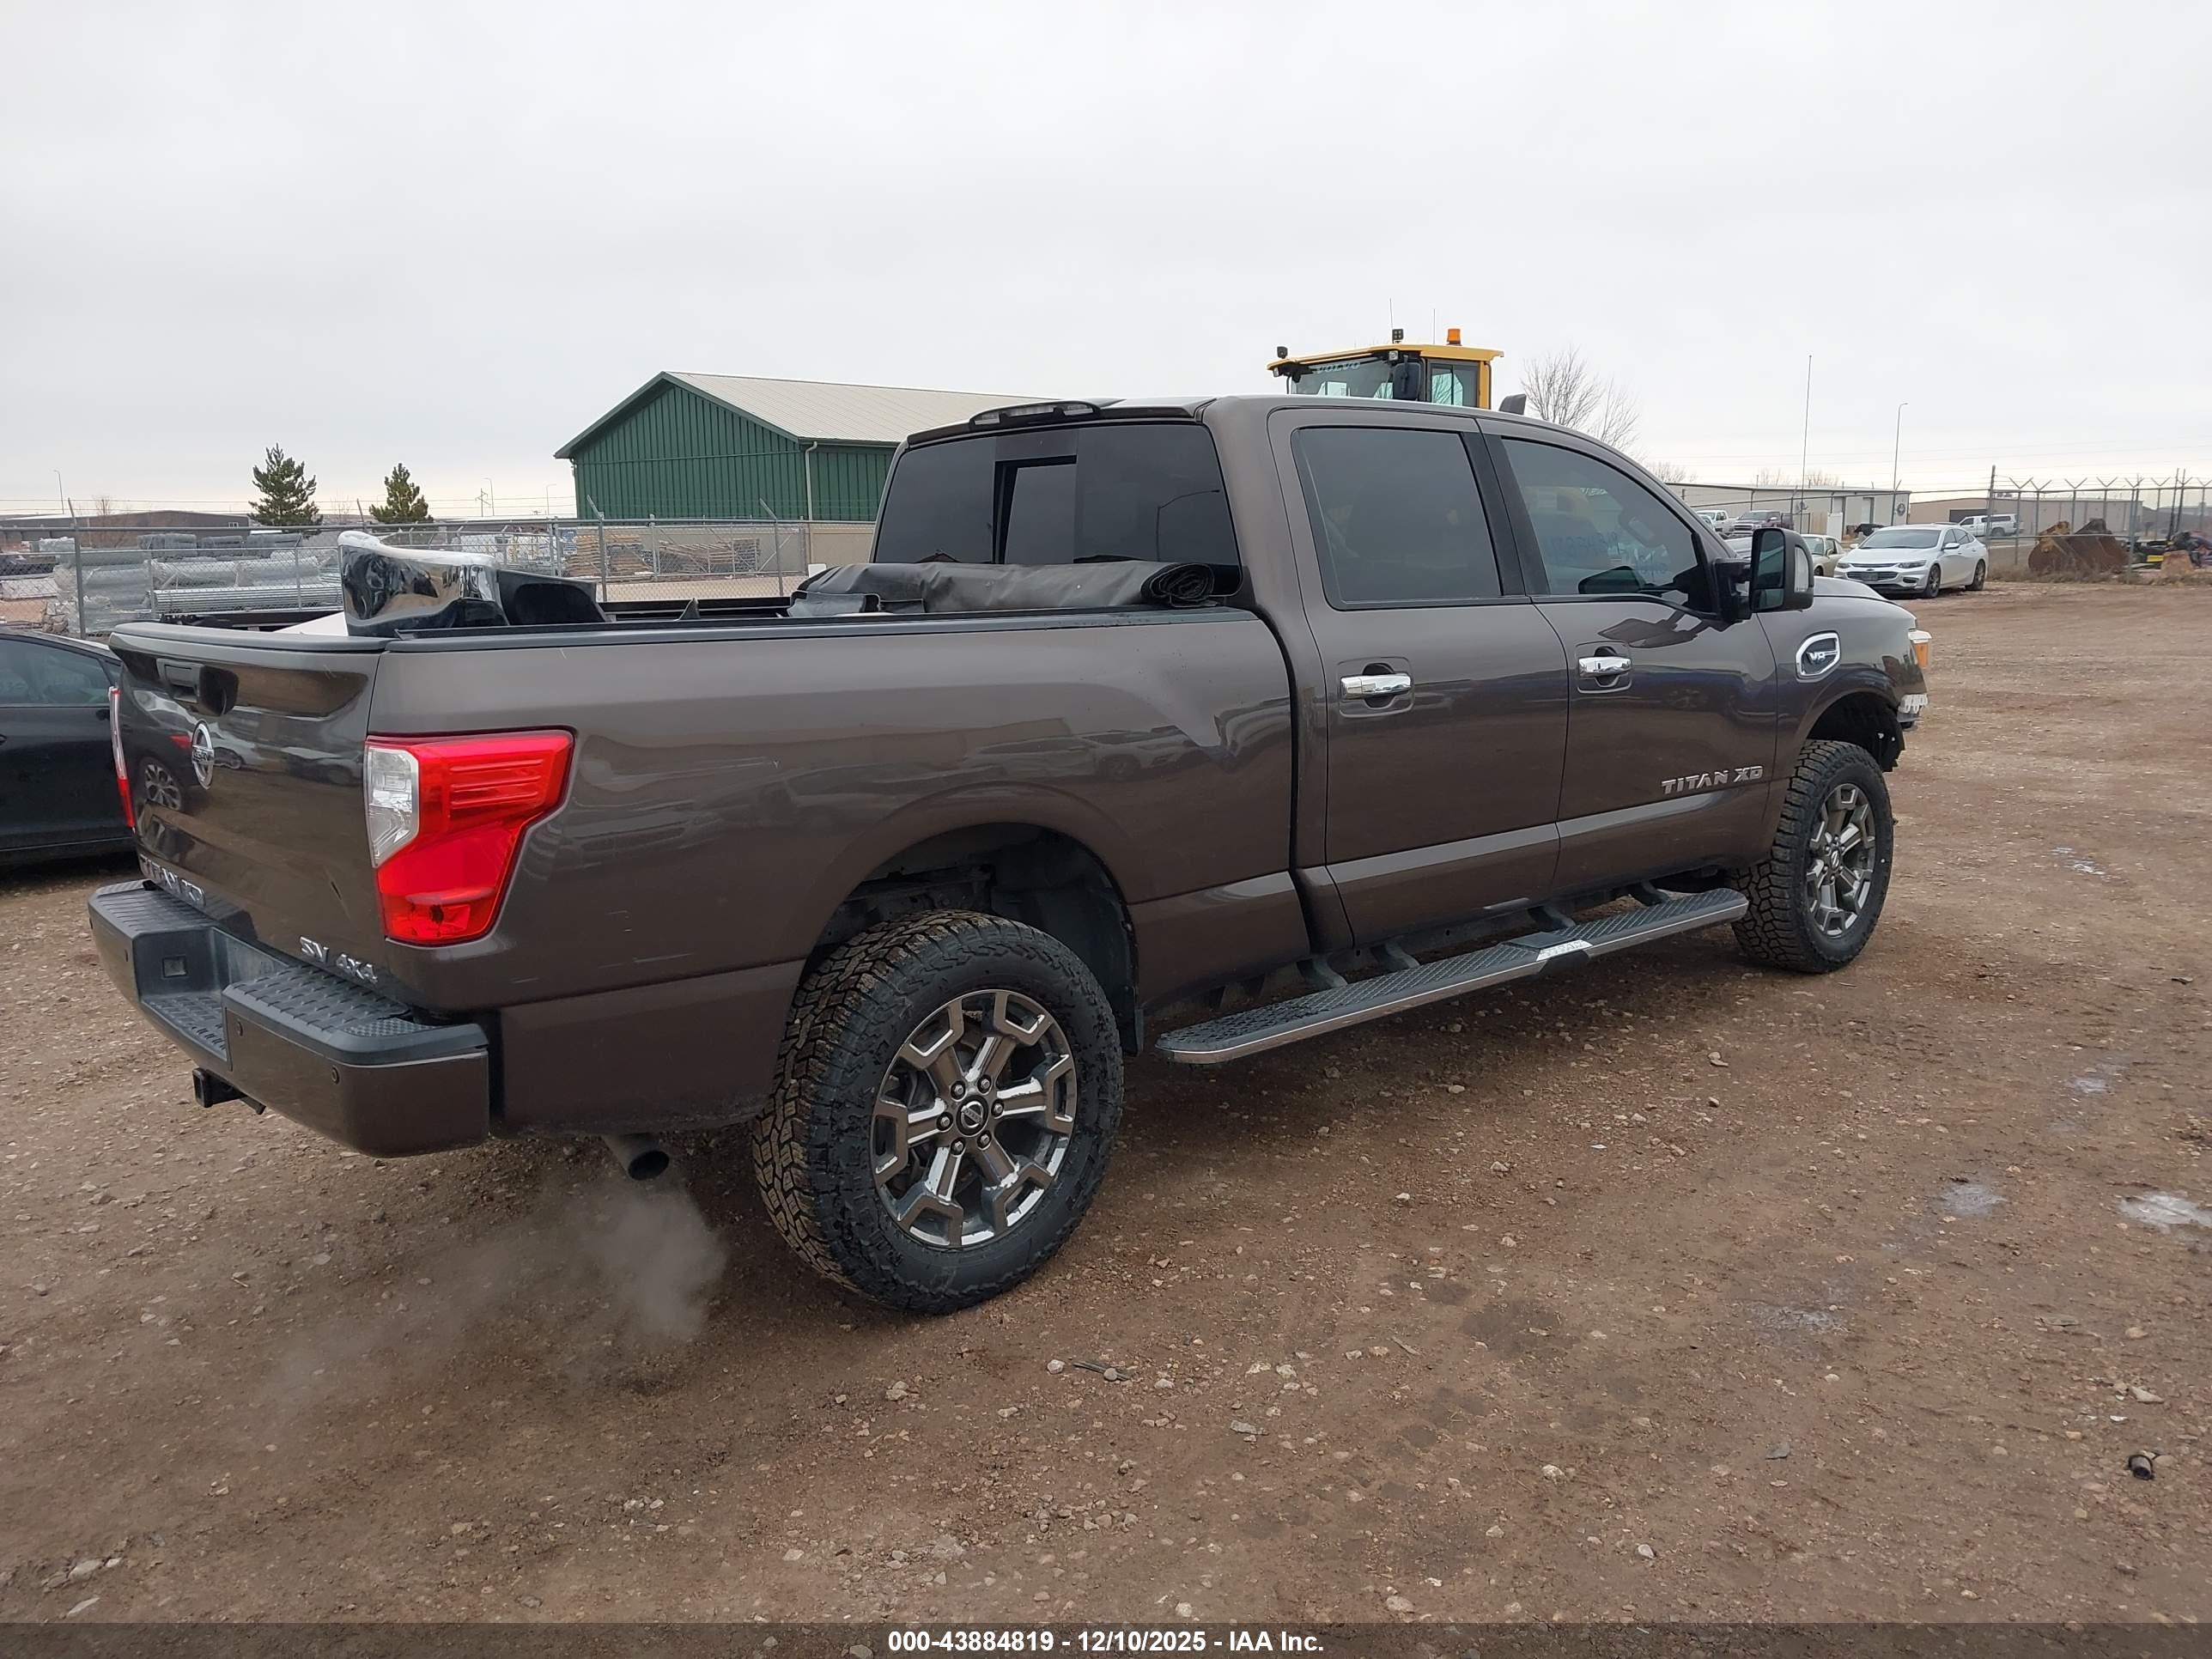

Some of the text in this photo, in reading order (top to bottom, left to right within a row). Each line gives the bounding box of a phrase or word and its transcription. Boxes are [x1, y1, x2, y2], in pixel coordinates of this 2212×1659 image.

[1316, 362, 1360, 374] VOLVO
[1806, 651, 1826, 660] V8
[1662, 766, 1763, 794] TITAN XD
